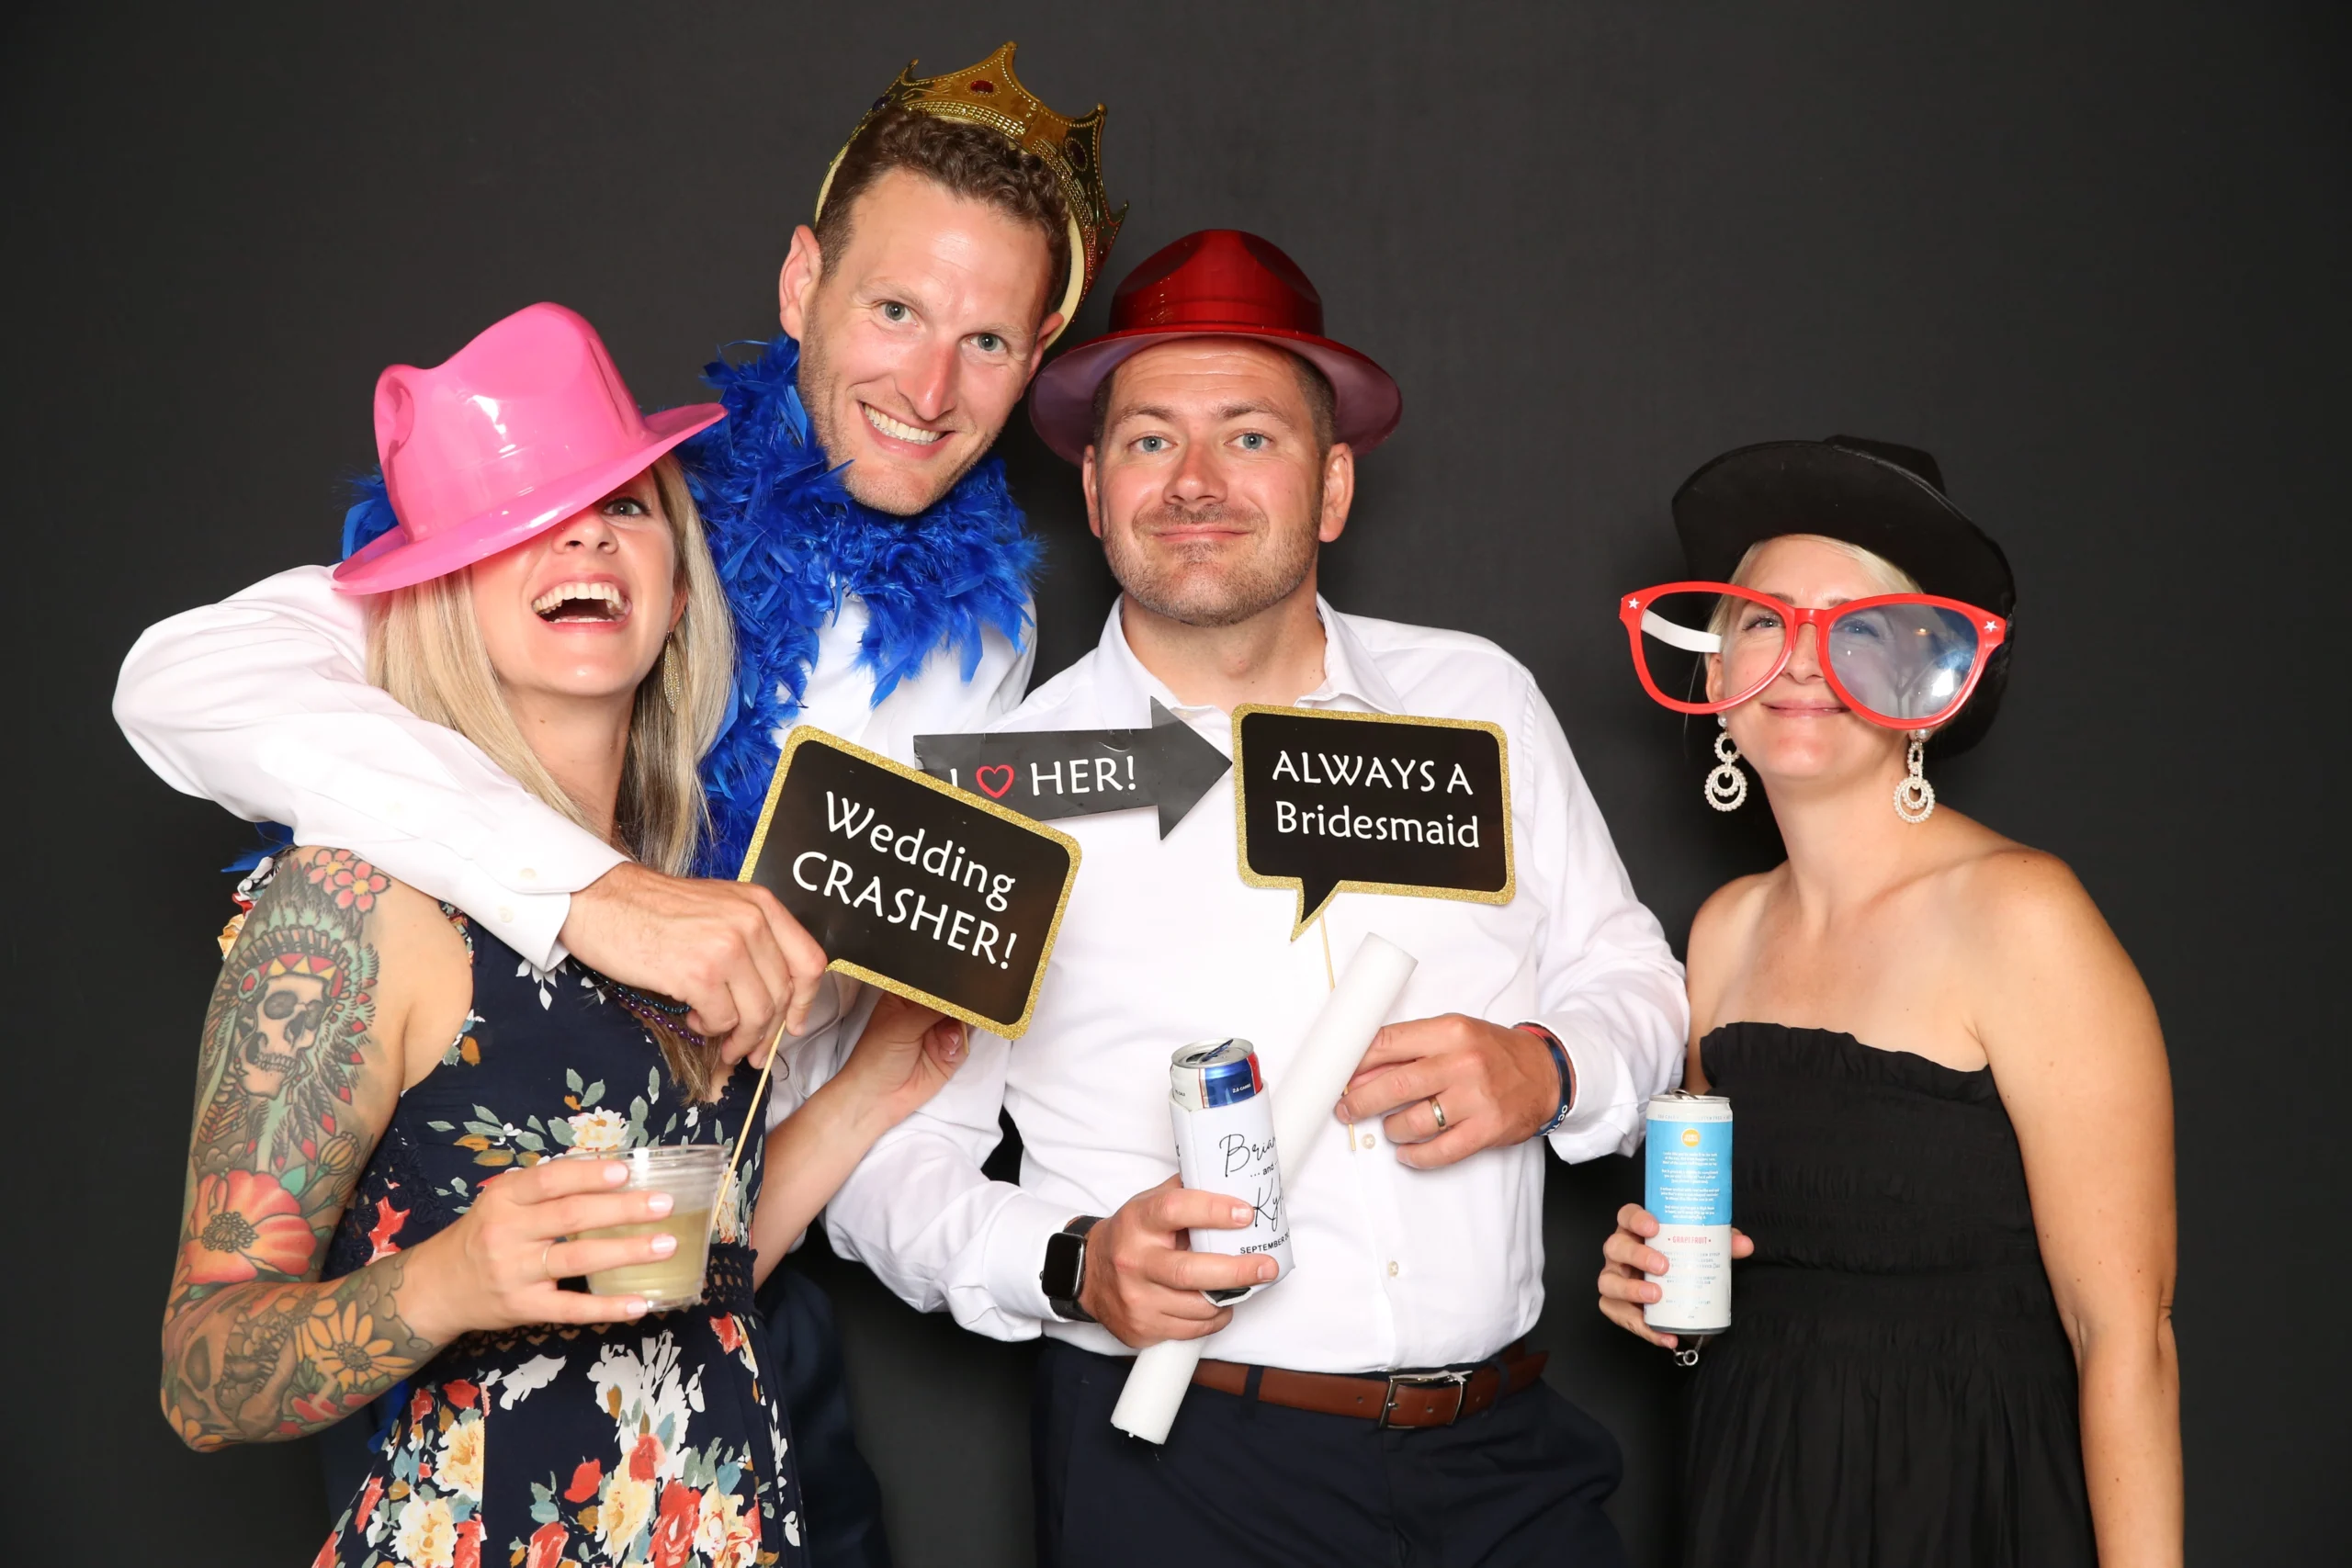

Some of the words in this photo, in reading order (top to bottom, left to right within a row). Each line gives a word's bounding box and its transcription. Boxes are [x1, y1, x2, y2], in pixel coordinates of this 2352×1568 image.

[1029, 755, 1136, 796] HER!
[1272, 750, 1436, 792] ALWAYS
[1446, 762, 1474, 795] A
[1275, 800, 1480, 848] Bridesmaid
[826, 791, 1016, 912] Wedding
[792, 851, 1017, 970] CRASHER!
[1262, 1161, 1274, 1176] and
[1239, 1235, 1284, 1255] SEPTEMBER
